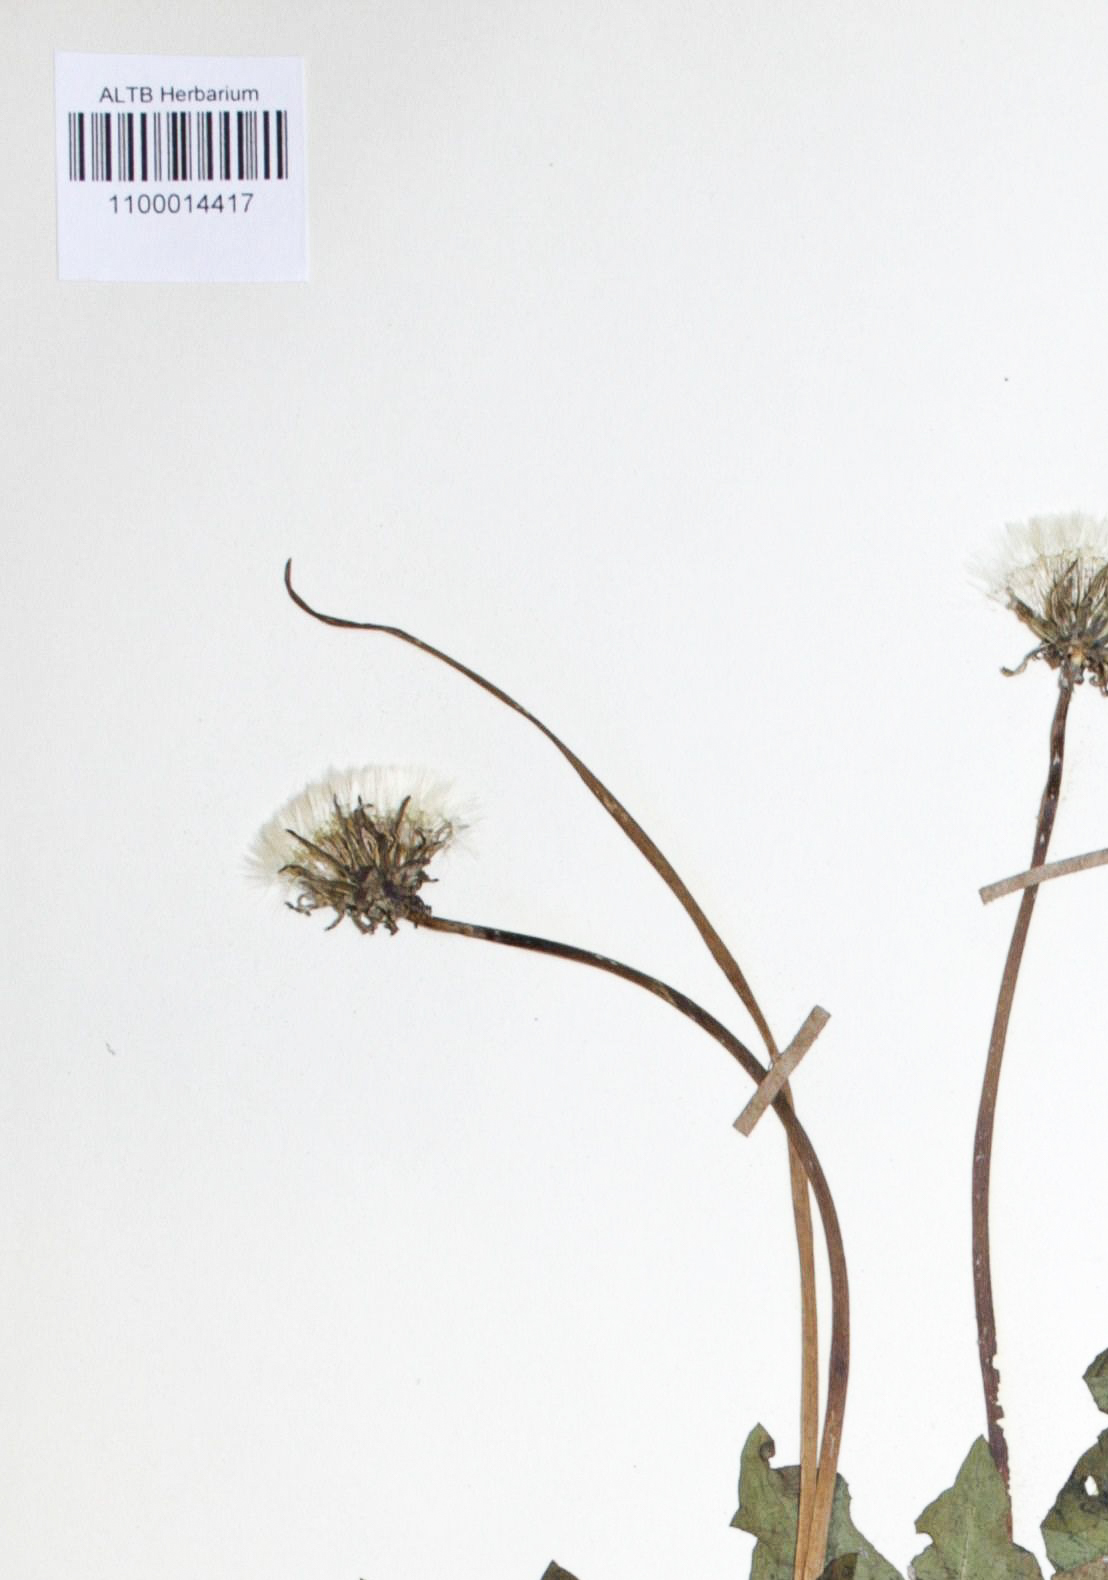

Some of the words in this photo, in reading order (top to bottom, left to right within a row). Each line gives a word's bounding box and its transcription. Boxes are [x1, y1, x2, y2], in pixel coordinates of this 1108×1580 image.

[99, 86, 153, 103] ALTB
[160, 86, 259, 102] Herbarium
[109, 193, 254, 214] 1100014417
